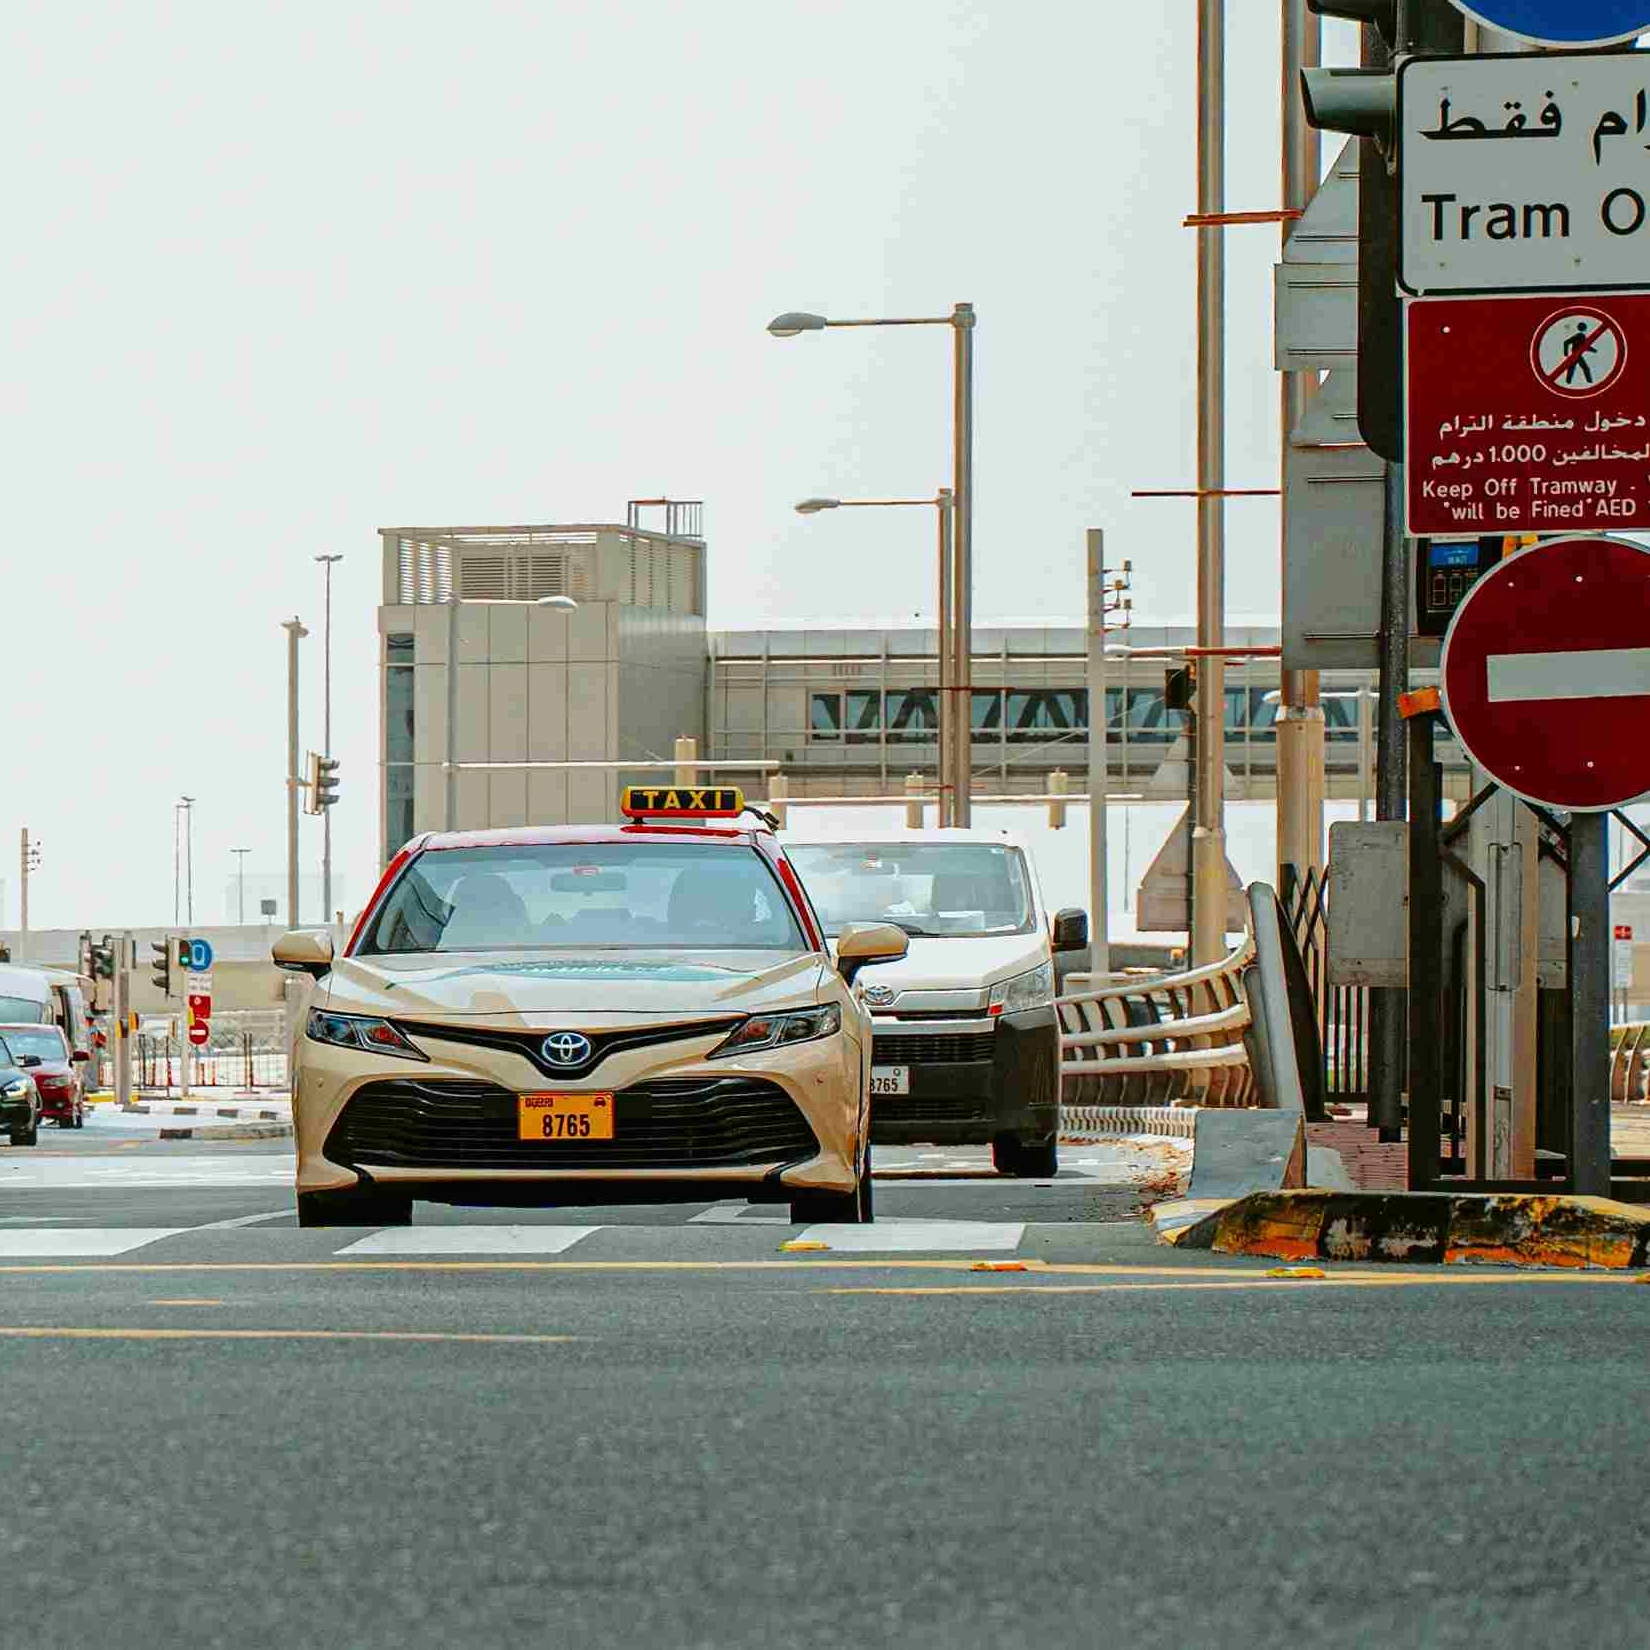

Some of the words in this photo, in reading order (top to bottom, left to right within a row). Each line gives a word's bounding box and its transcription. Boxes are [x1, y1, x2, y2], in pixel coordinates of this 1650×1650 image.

[1417, 90, 1562, 140] فقط
[1420, 193, 1570, 241] Tram
[1439, 414, 1493, 440] الترام
[1501, 413, 1575, 431] منطقة
[1584, 410, 1646, 432] دخول
[1431, 450, 1485, 469] درهم
[1488, 444, 1547, 463] 1.000
[1422, 480, 1473, 500] Keep
[1484, 478, 1517, 496] Off
[1529, 477, 1617, 497] Tramway
[1451, 502, 1485, 520] will
[1496, 502, 1520, 519] be
[1531, 500, 1584, 518] Fined
[1595, 498, 1637, 517] AED
[643, 790, 721, 809] TAXI
[542, 1114, 591, 1137] 8765
